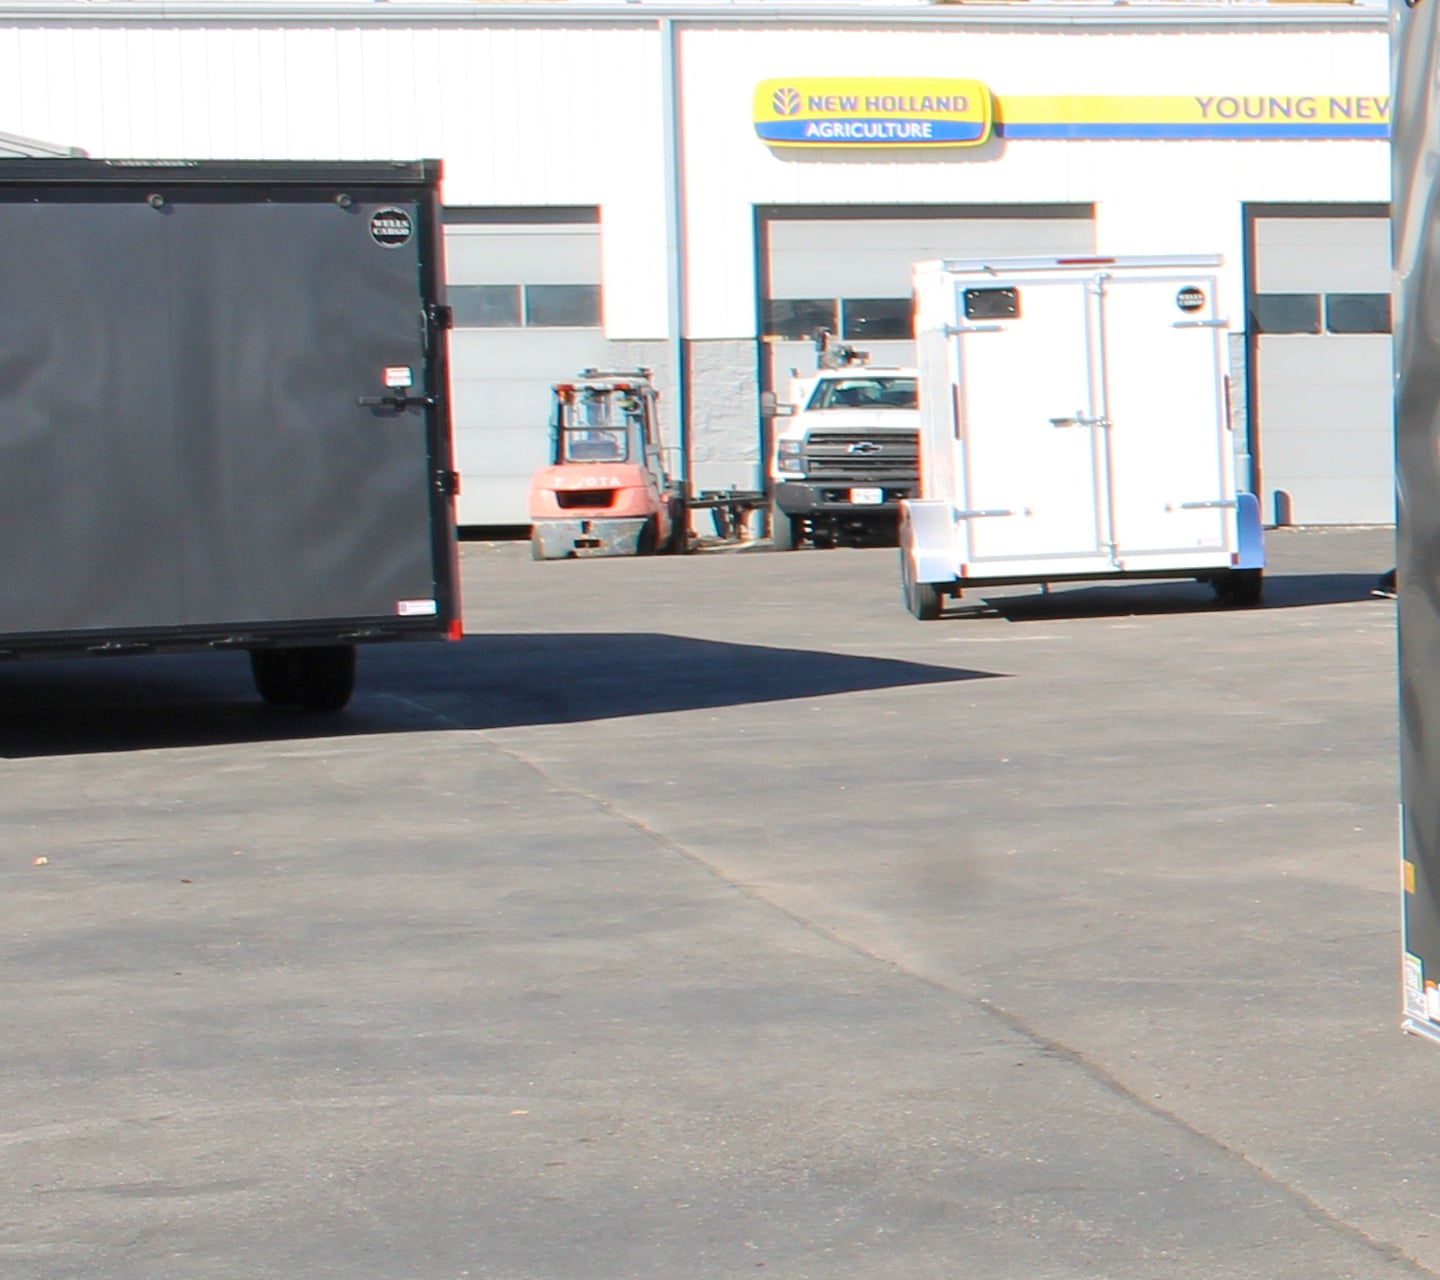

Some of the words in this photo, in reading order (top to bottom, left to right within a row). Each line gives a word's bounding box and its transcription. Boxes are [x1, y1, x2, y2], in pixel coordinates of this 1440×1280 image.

[808, 95, 860, 112] NEW
[865, 95, 969, 112] HOLLAND
[1195, 96, 1318, 119] YOUNG
[806, 122, 933, 138] AGRICULTURE
[372, 219, 410, 228] WELLS
[373, 227, 410, 236] CARGO
[554, 476, 621, 487] TOTA
